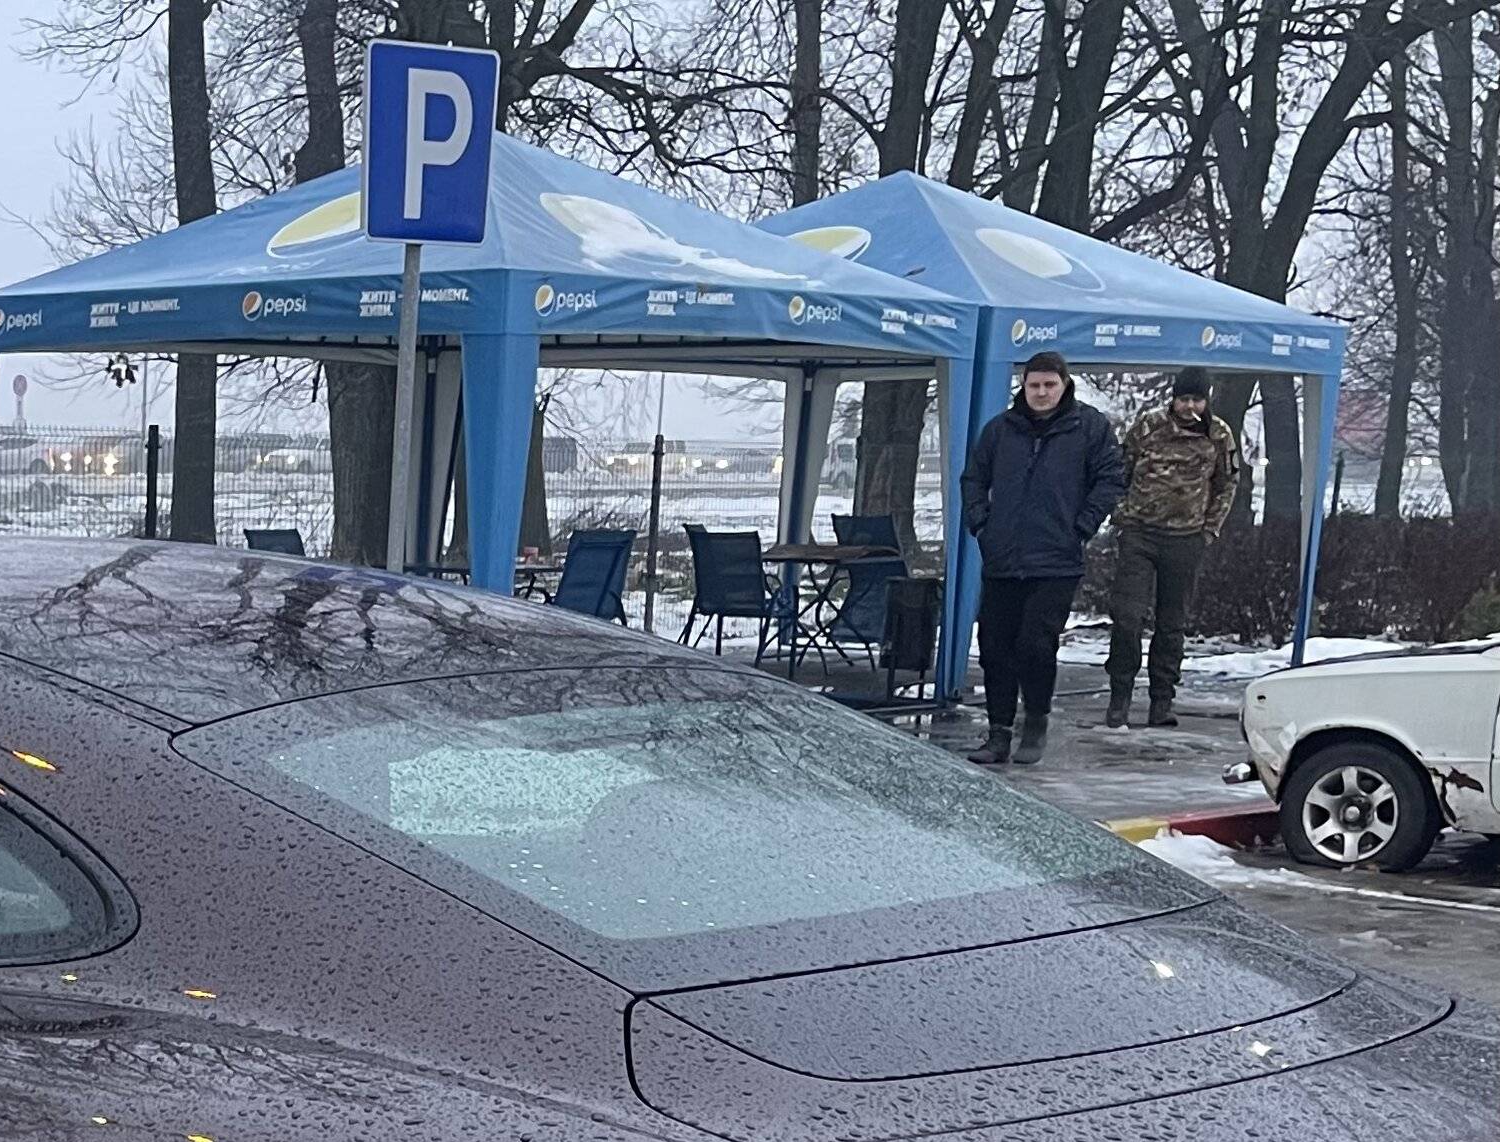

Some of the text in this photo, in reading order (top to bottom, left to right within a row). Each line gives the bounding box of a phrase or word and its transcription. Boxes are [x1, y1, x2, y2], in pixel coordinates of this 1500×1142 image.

[403, 67, 473, 219] P
[263, 294, 306, 317] pepsi
[555, 289, 597, 312] pepsi
[6, 308, 42, 332] pepsi
[806, 304, 842, 324] pepsi
[1027, 323, 1057, 343] pepsi
[1215, 332, 1242, 348] pepsi
